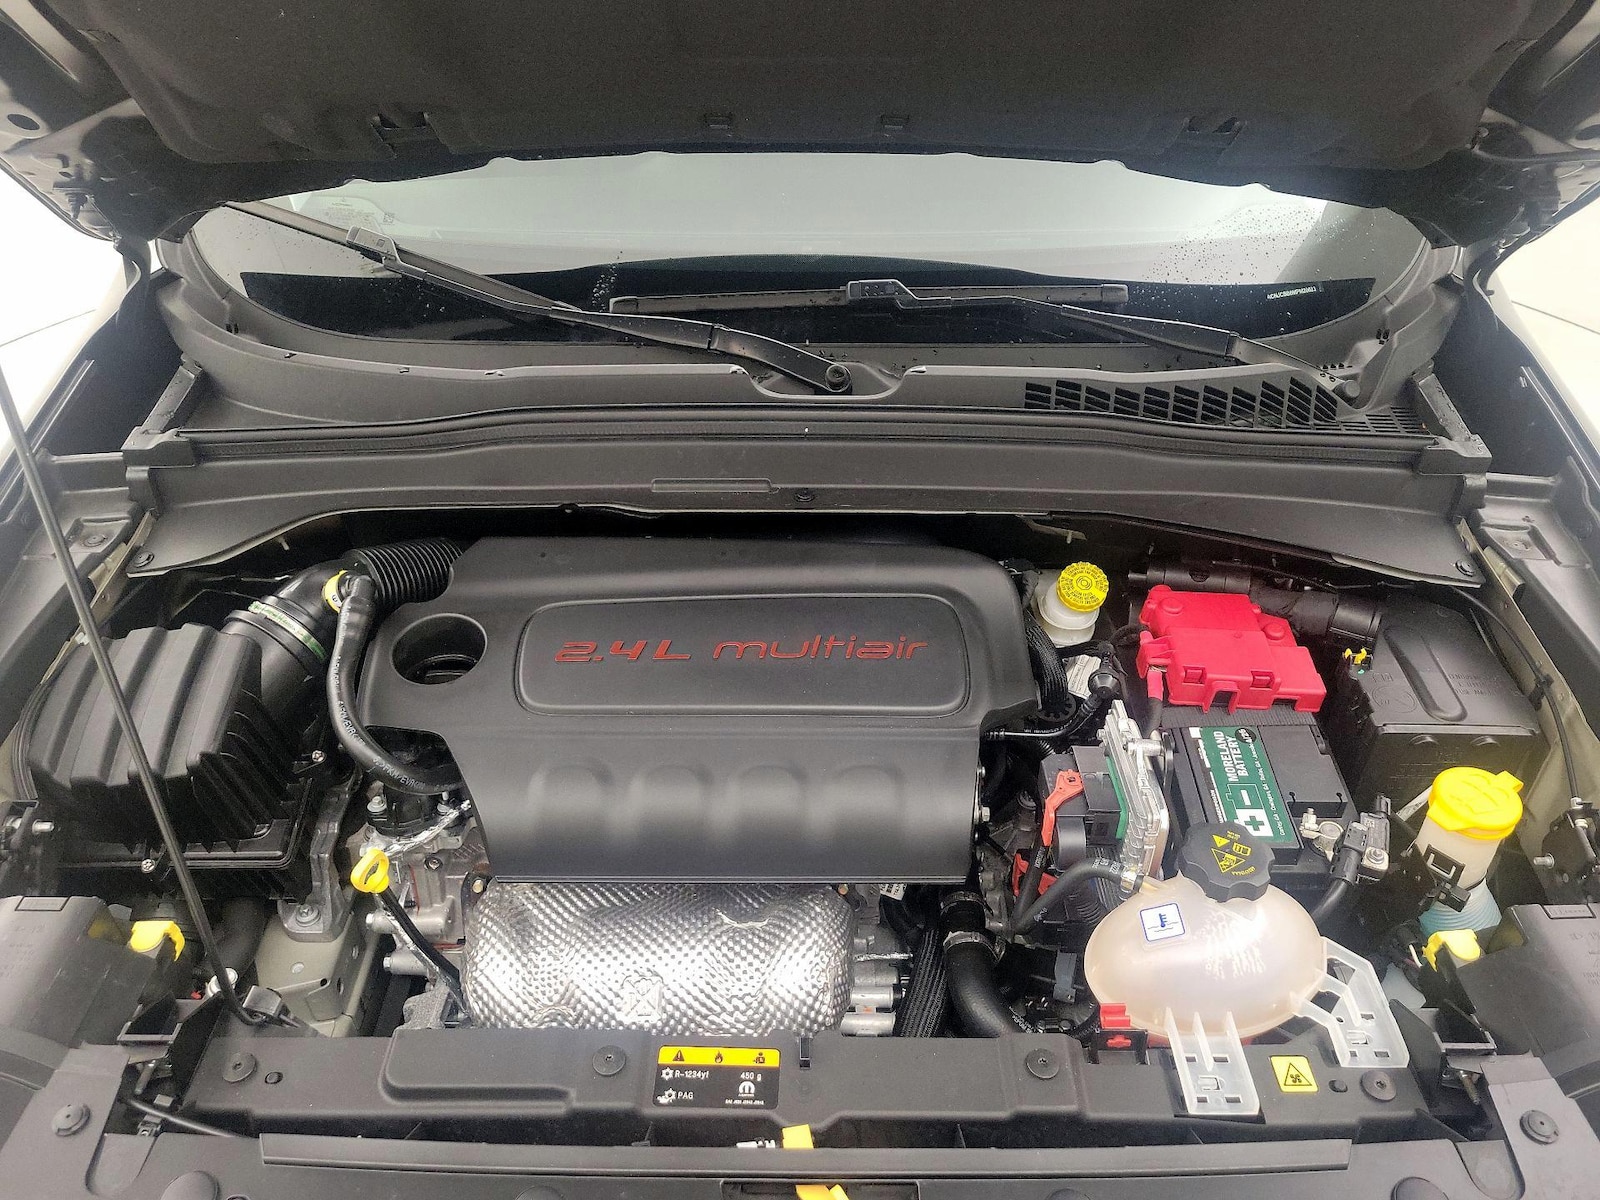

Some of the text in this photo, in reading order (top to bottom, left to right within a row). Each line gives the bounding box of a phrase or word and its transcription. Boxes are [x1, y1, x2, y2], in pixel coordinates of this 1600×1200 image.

[712, 635, 928, 660] multiair
[1213, 730, 1240, 782] MORELAND
[1225, 735, 1249, 777] BATTERY
[674, 1070, 709, 1080] R-1234yf
[740, 1072, 754, 1080] 450
[677, 1092, 694, 1100] PAG
